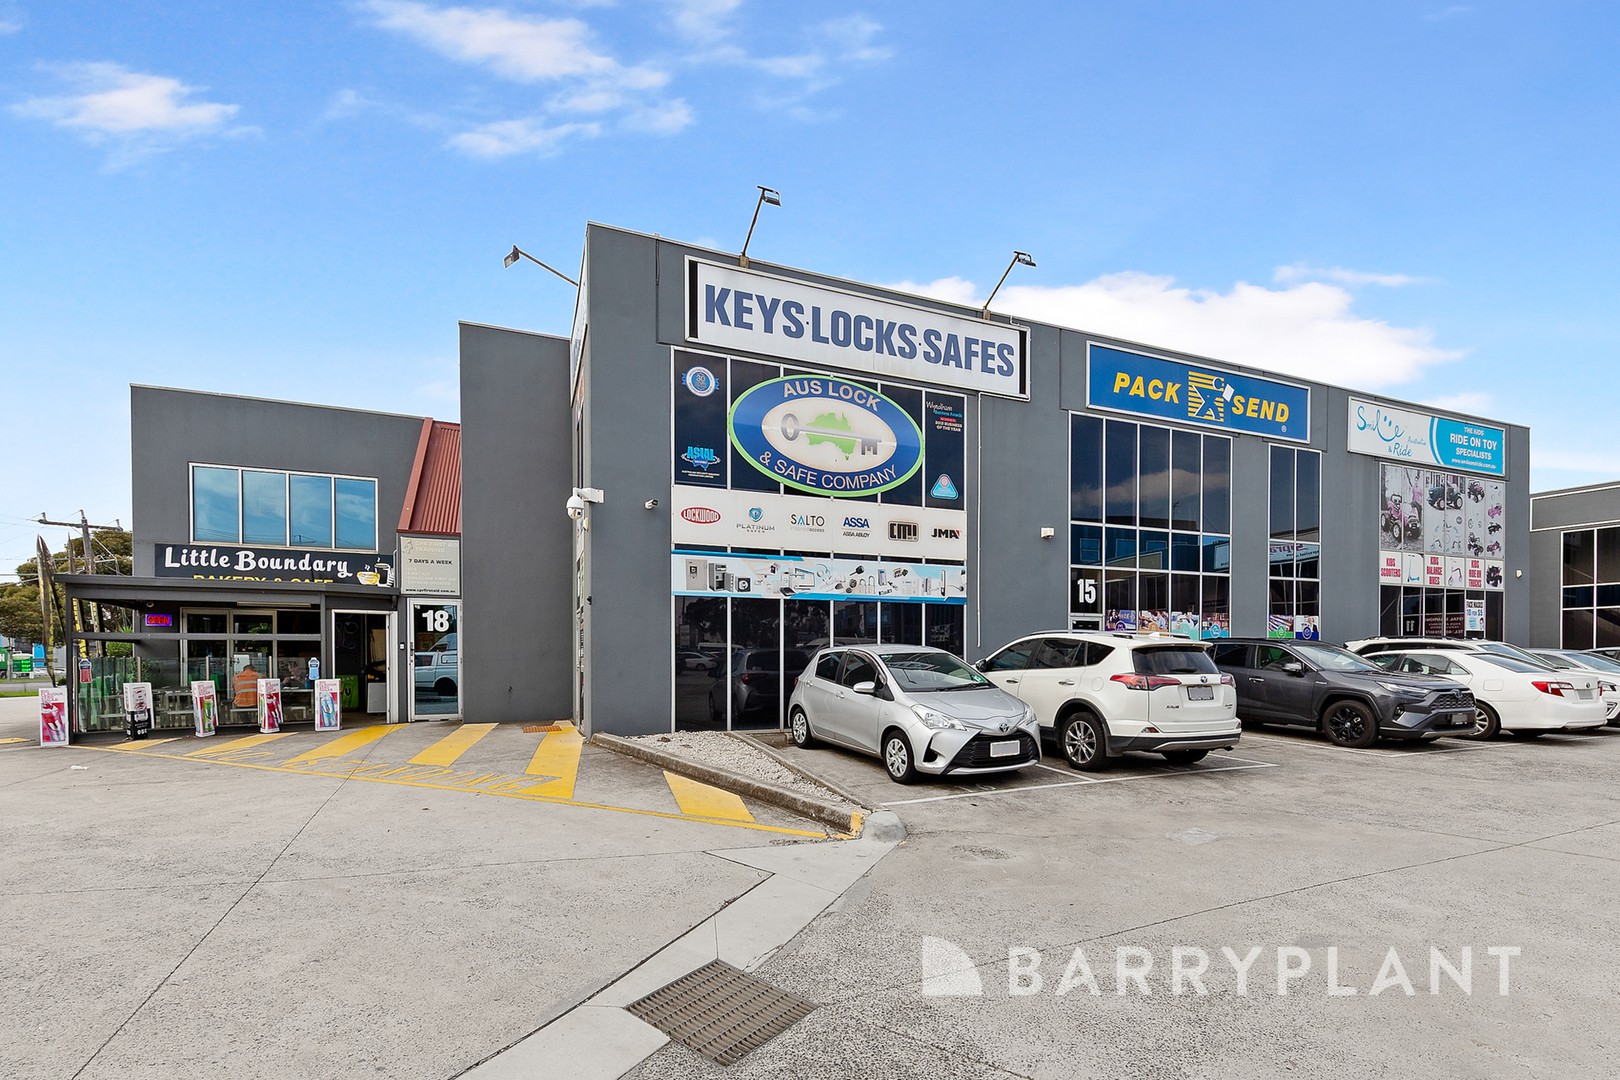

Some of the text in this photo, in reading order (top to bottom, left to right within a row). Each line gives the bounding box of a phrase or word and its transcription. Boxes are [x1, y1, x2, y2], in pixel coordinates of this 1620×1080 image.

[705, 284, 1014, 377] KEYS LOCKS SAFES
[783, 380, 881, 412] AUS LOCK
[1113, 372, 1290, 423] PACK SEND
[1450, 432, 1498, 451] RIDE ON TOY
[1393, 442, 1412, 457] Ride
[1455, 447, 1492, 460] SPECIALISTS
[759, 451, 898, 490] & SAFE COMPANY
[683, 508, 719, 522] LOCKWOOD
[790, 513, 825, 527] SALTO
[736, 523, 775, 531] PLATINUM
[843, 517, 870, 528] ASSA
[931, 528, 960, 539] JMA
[164, 546, 353, 578] Little Boundary
[1386, 558, 1395, 567] KIDS
[1430, 556, 1439, 565] KIDS
[1471, 560, 1480, 568] KIDS
[1381, 568, 1401, 577] SCOOTERS
[1426, 566, 1443, 576] BALANCE
[1429, 576, 1440, 585] BIKES
[1469, 579, 1482, 588] TRUCKS
[1077, 579, 1096, 603] 15
[147, 615, 170, 624] OPEN
[422, 609, 450, 632] 18
